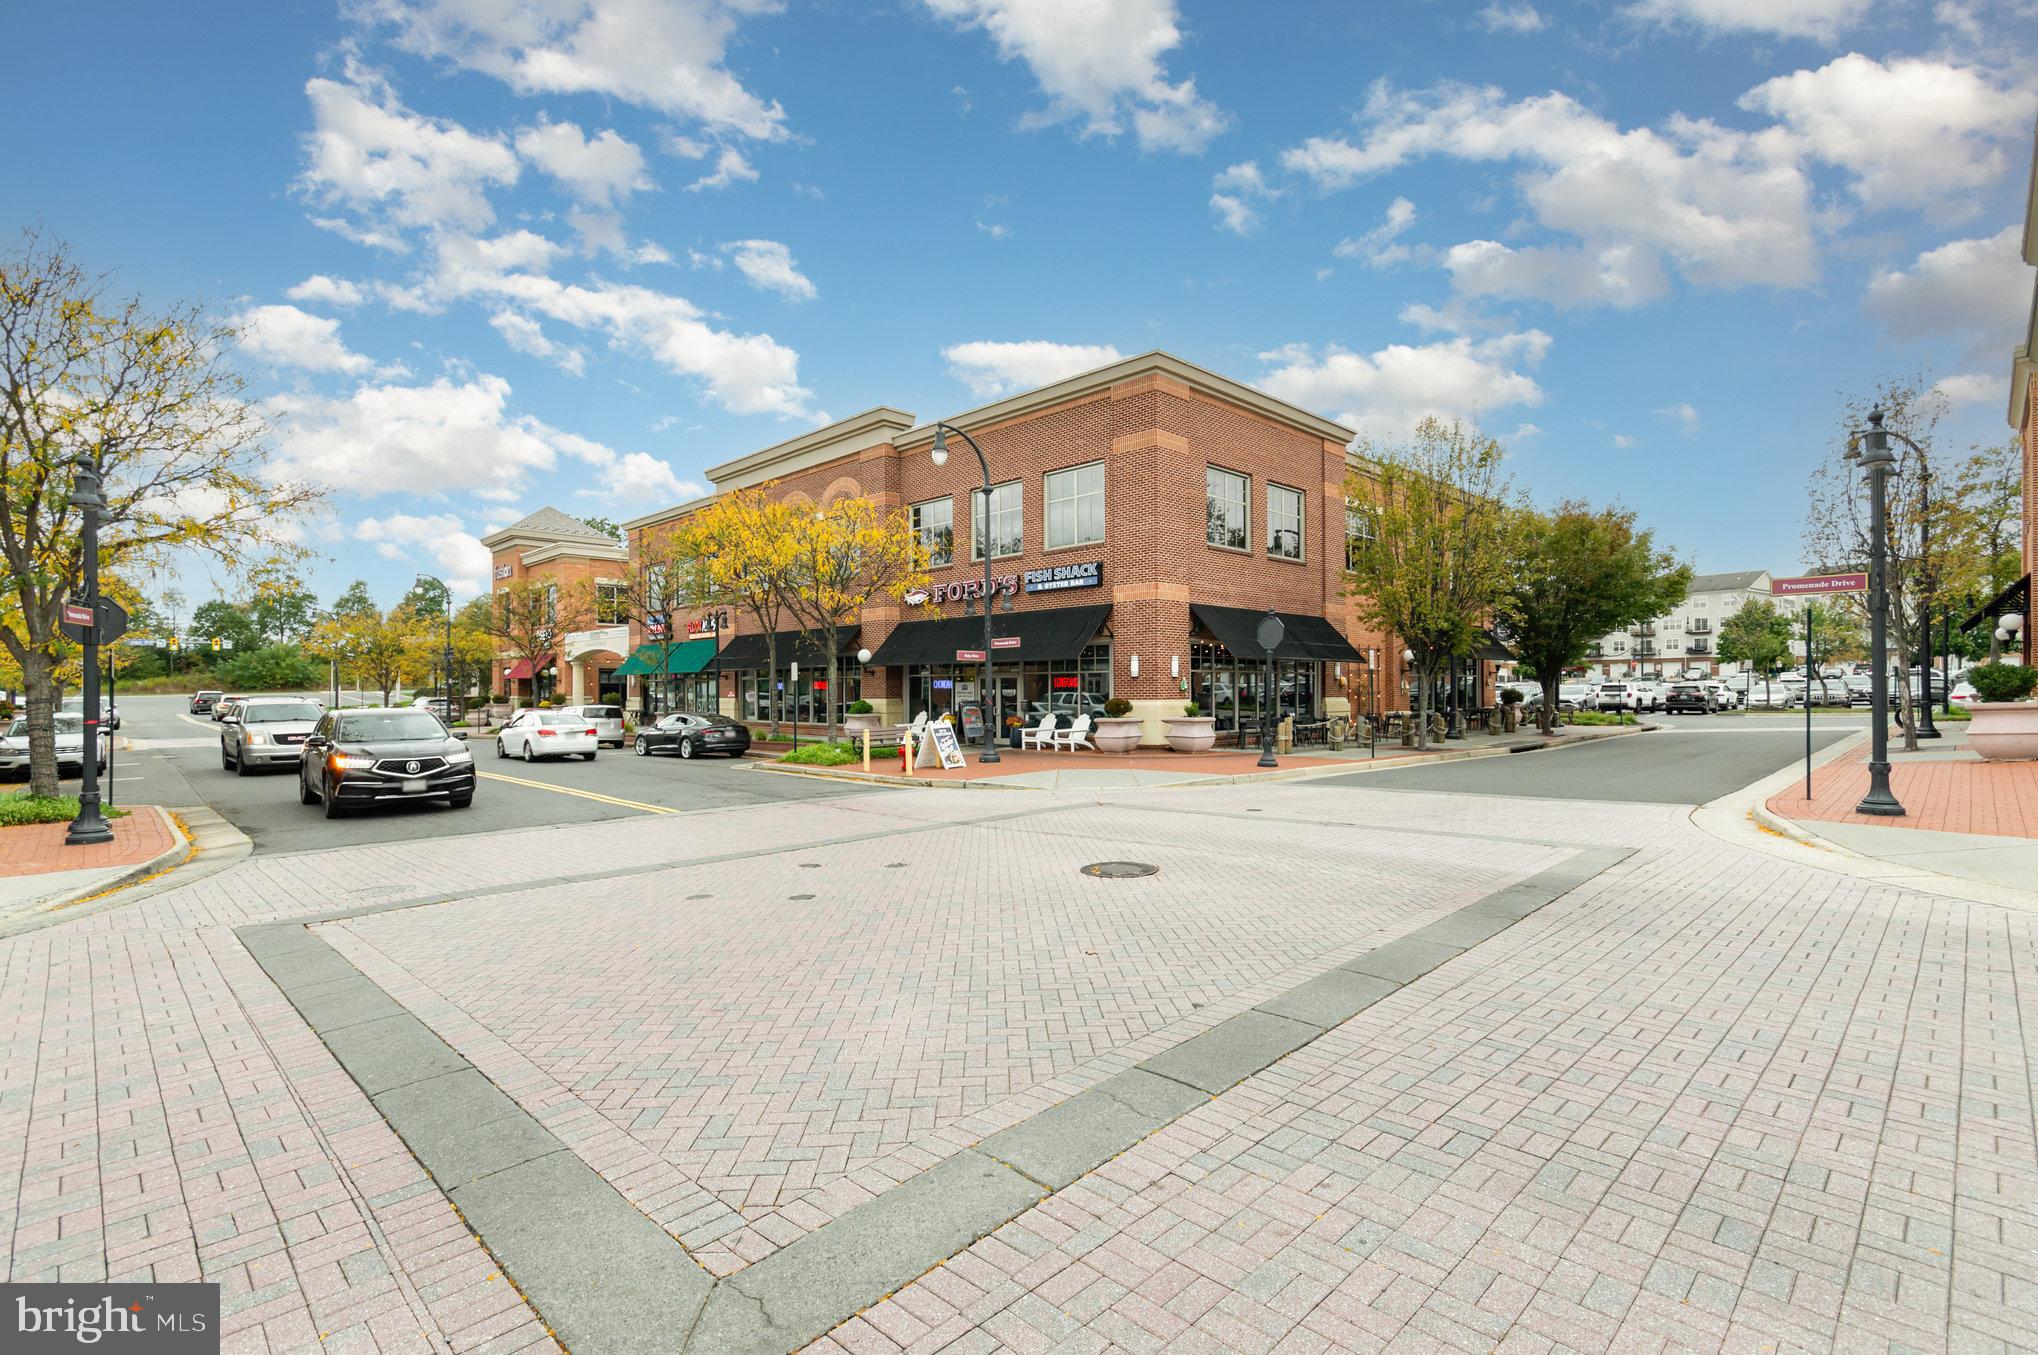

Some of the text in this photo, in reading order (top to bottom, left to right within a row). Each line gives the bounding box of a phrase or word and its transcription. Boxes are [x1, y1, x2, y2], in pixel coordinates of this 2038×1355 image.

[1024, 562, 1098, 583] FISH SHACK
[933, 575, 1018, 603] FORD'S
[1044, 580, 1069, 588] OYSTER
[1782, 579, 1856, 590] Promenade Drive
